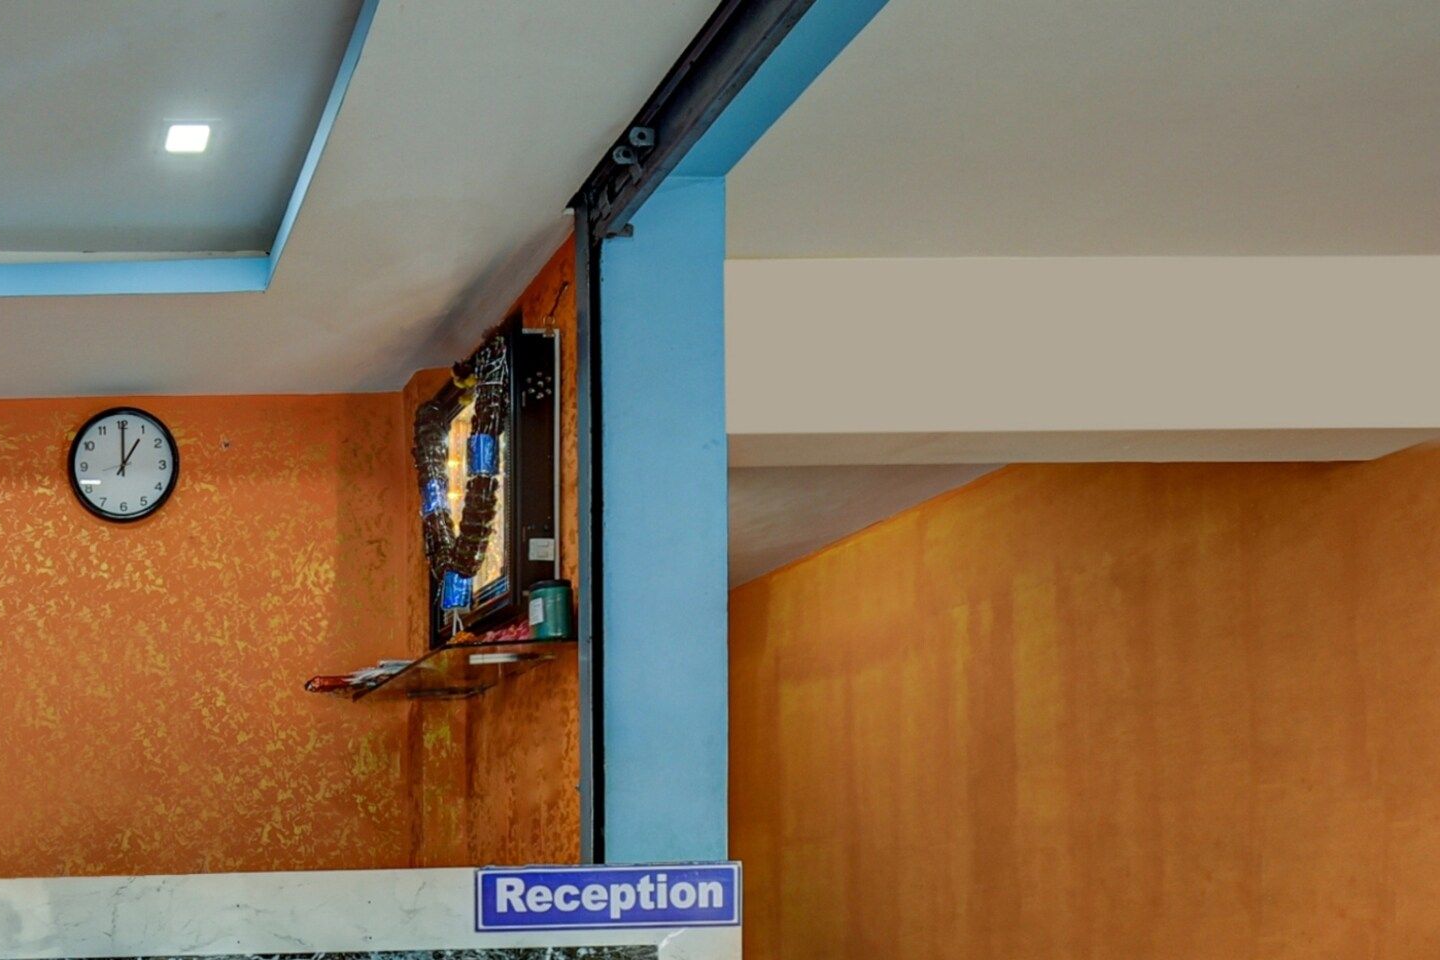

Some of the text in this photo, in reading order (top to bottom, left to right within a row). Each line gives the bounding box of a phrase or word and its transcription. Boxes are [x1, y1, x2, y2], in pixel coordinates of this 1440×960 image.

[117, 420, 128, 430] 12
[141, 425, 145, 434] 1
[98, 426, 107, 435] 11
[84, 441, 95, 451] 10
[154, 438, 162, 448] 2
[80, 462, 88, 472] 9
[159, 460, 167, 470] 3
[85, 485, 93, 494] 8
[154, 482, 163, 491] 4
[100, 497, 107, 507] 7
[140, 496, 148, 506] 5
[120, 501, 128, 512] 6
[496, 874, 724, 919] Reception
